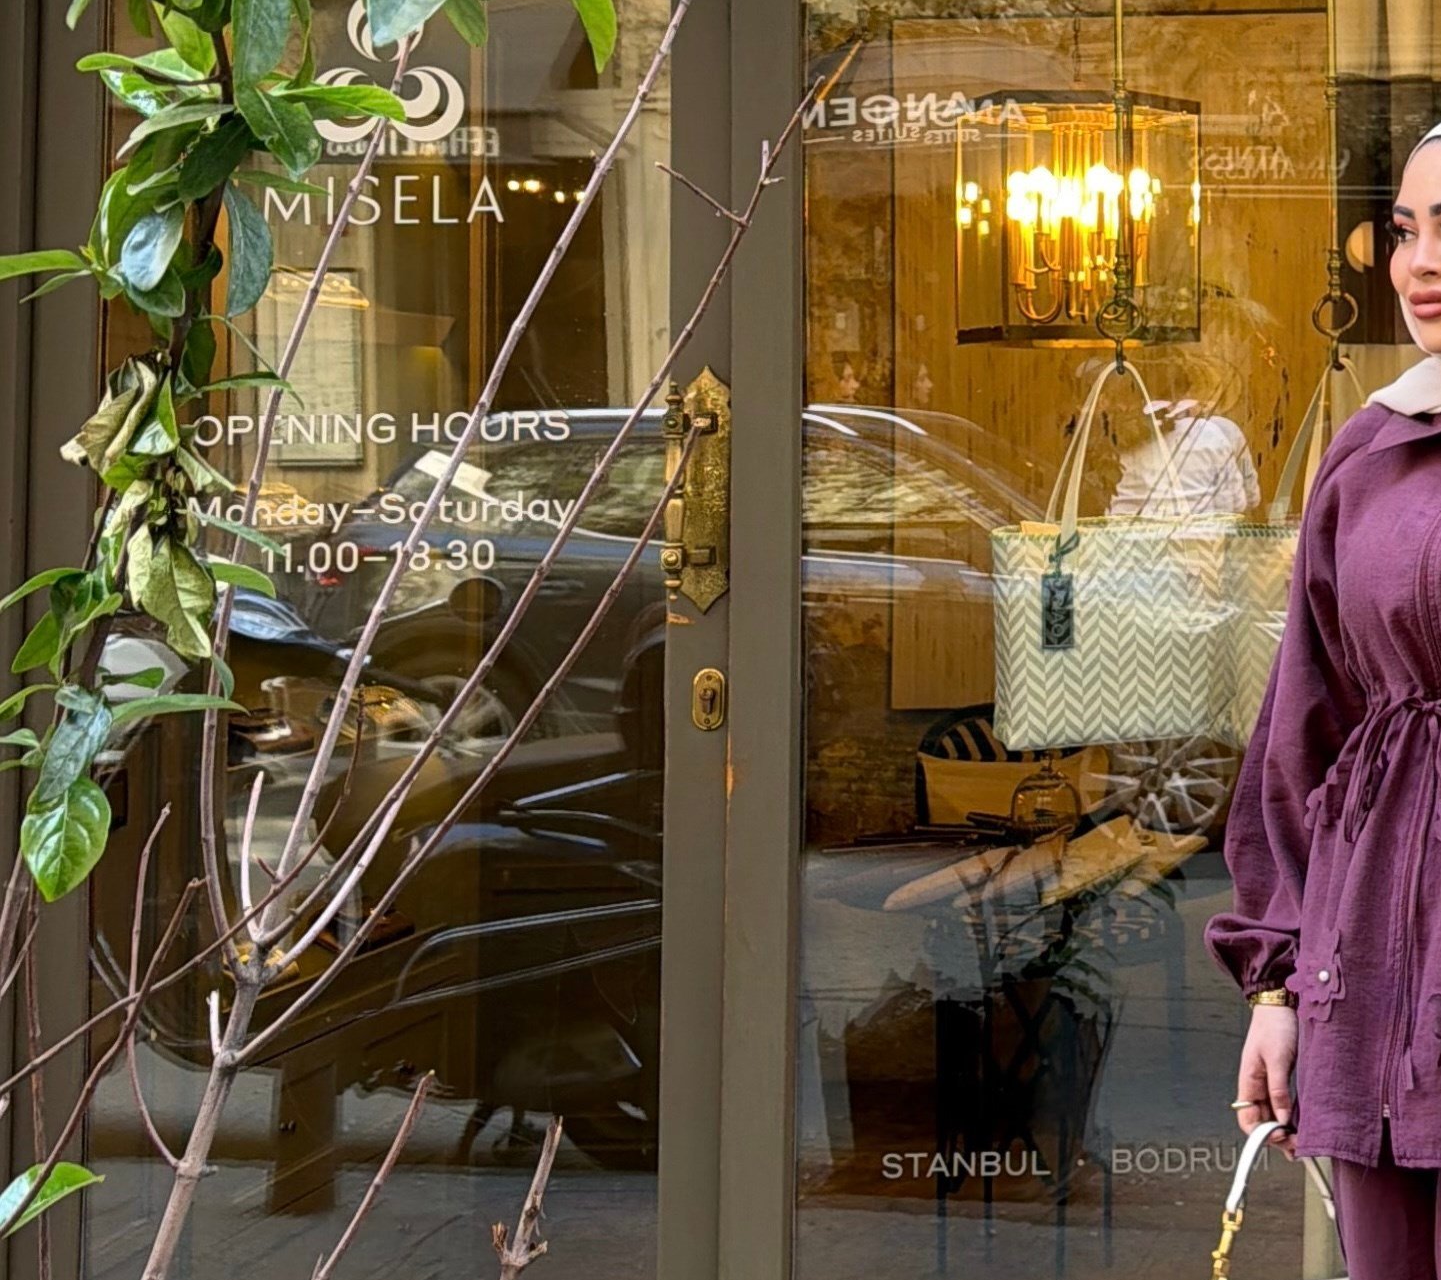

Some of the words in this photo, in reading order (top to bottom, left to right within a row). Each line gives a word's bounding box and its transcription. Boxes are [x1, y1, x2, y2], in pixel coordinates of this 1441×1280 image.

[263, 175, 505, 226] MISELA
[194, 412, 397, 447] OPENING
[411, 410, 570, 443] HOURS
[881, 1150, 1052, 1179] STANBUL
